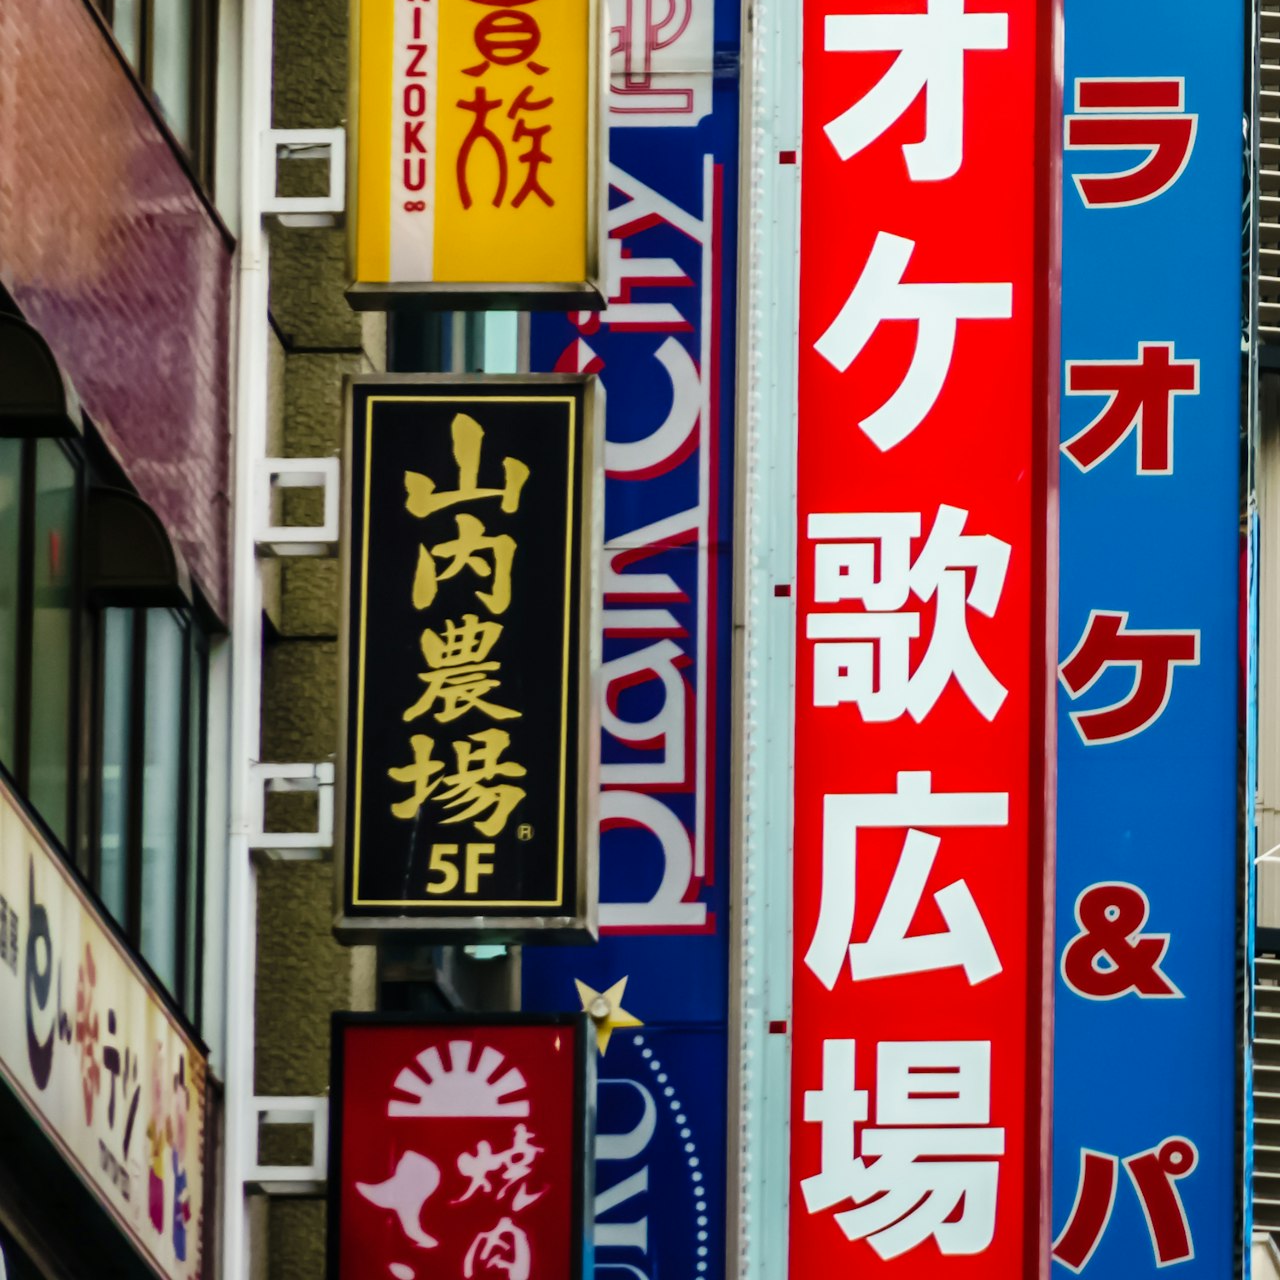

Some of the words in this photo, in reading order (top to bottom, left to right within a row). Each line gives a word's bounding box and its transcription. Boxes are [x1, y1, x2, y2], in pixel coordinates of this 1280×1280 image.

[388, 413, 530, 837] 山内農場
[425, 843, 495, 894] 5F
